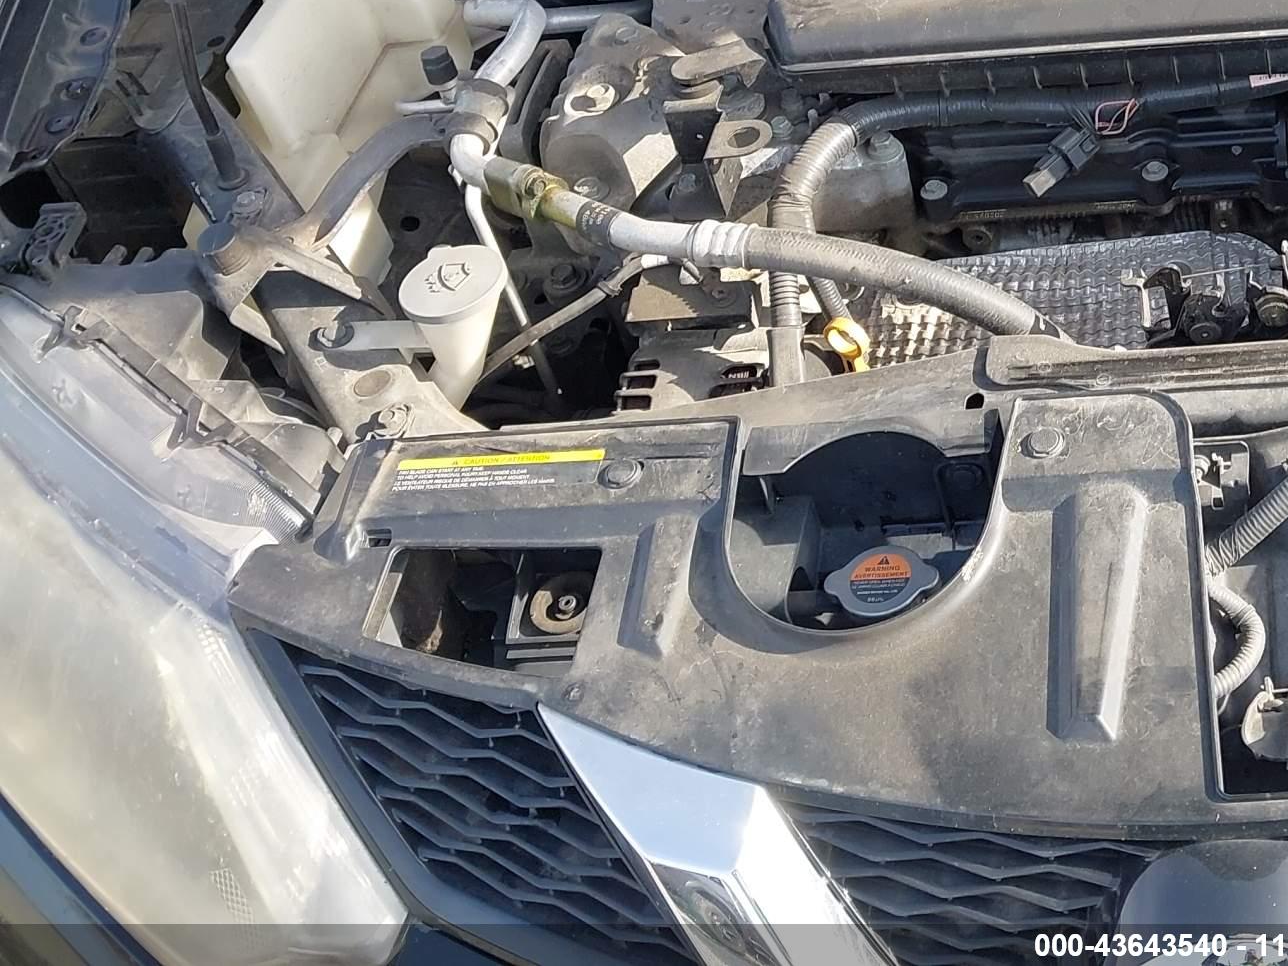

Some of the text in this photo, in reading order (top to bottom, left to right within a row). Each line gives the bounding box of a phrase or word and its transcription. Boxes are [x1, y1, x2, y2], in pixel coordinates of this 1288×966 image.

[464, 457, 499, 465] CAUTION
[508, 454, 550, 463] ATTENTION
[854, 571, 908, 579] AVERTISSEMENT
